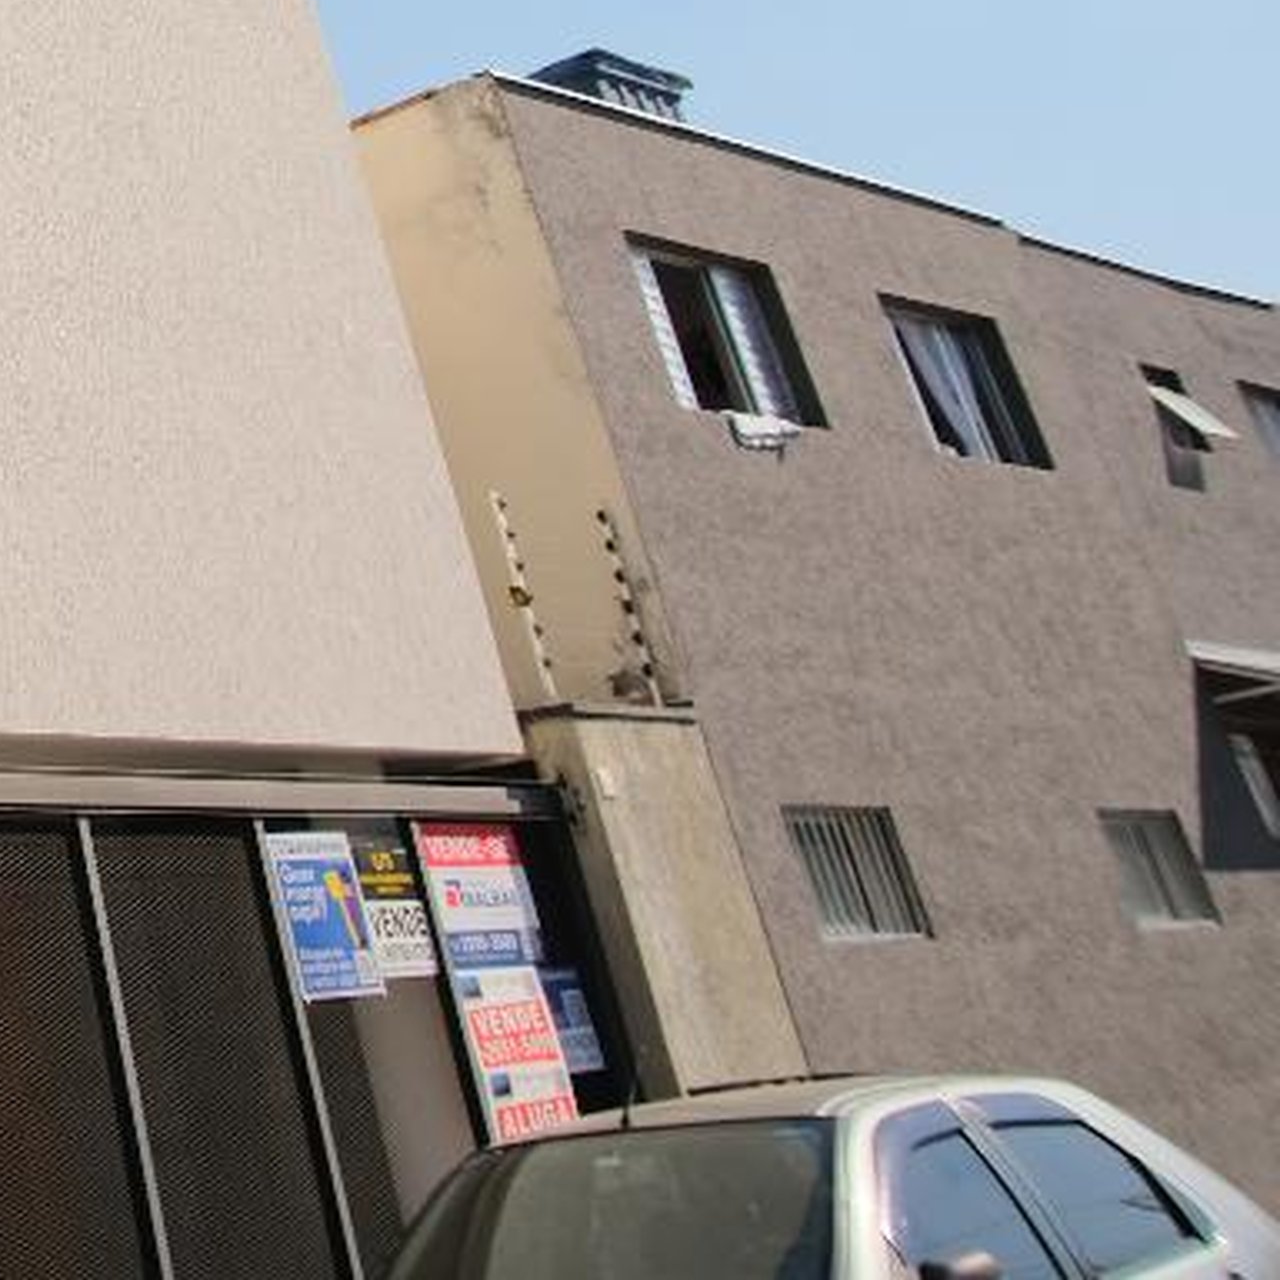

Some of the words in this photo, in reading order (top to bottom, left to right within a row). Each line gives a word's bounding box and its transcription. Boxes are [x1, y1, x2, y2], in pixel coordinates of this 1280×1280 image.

[425, 834, 509, 859] VENDE-SE
[371, 906, 430, 939] VENDE
[473, 1003, 546, 1039] VENDE
[500, 1099, 573, 1140] ALUGA
